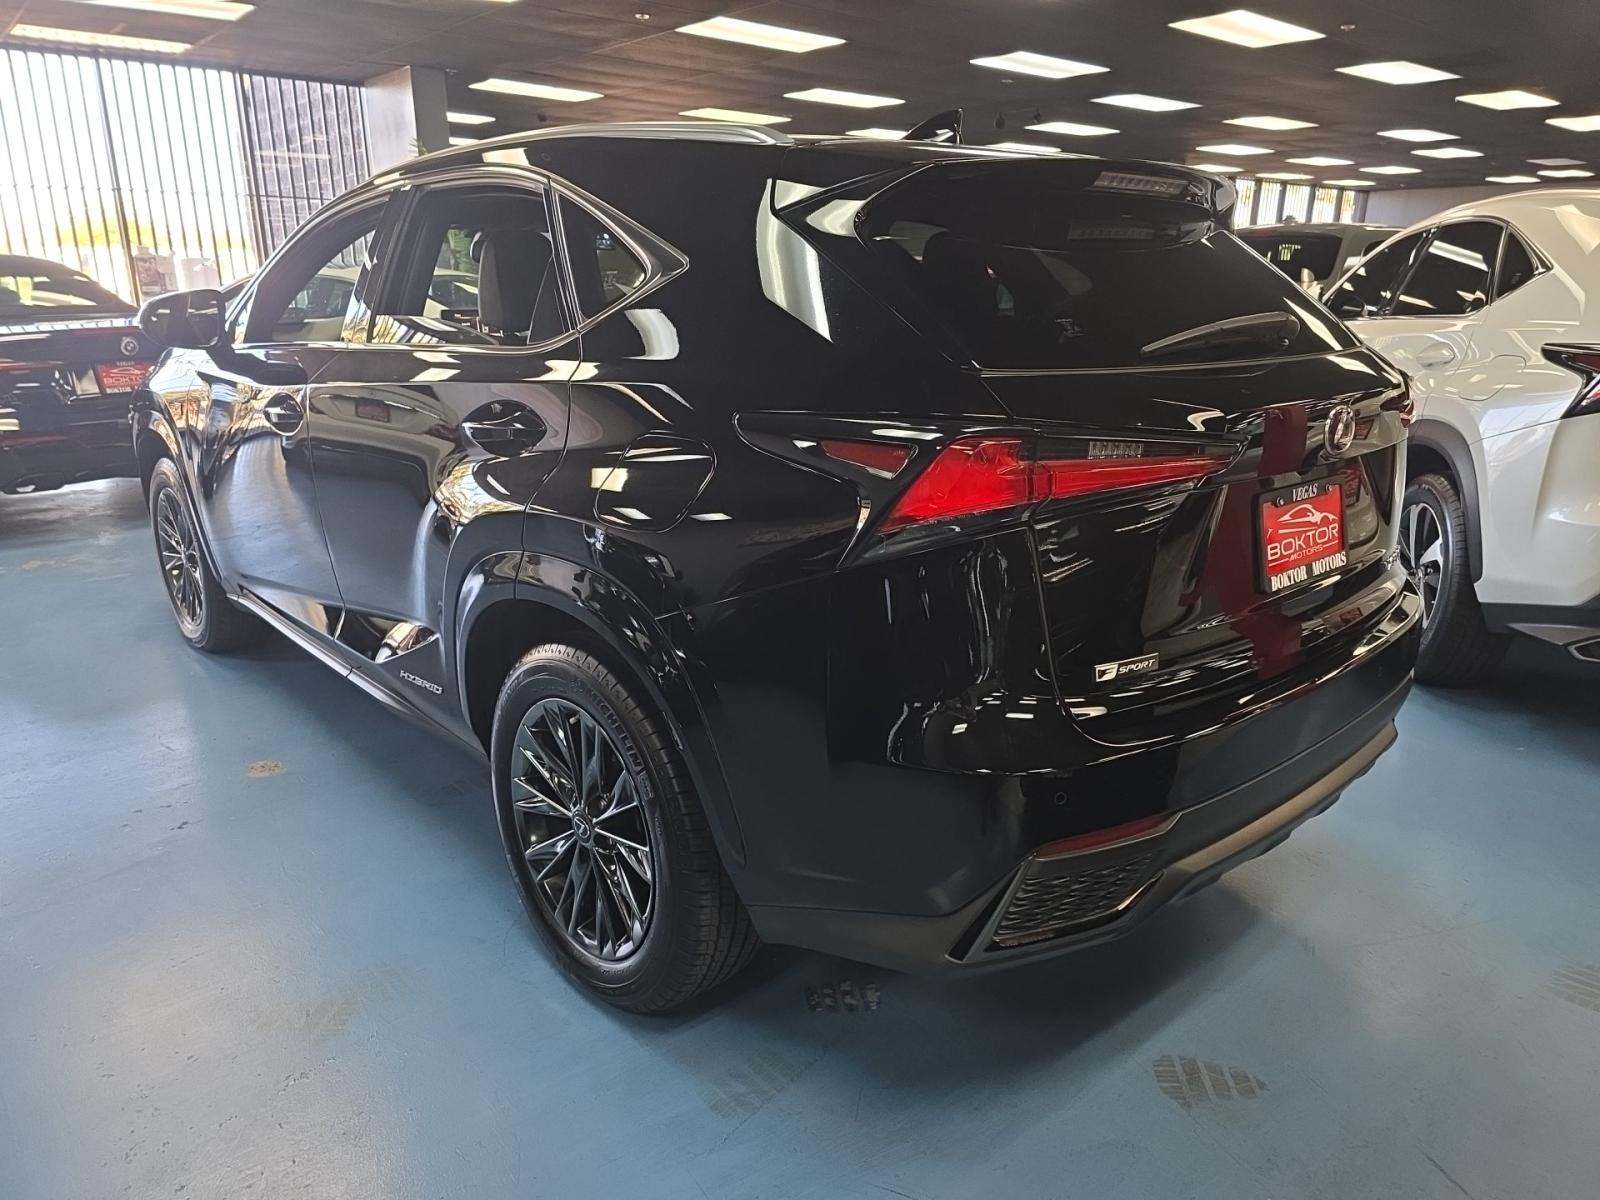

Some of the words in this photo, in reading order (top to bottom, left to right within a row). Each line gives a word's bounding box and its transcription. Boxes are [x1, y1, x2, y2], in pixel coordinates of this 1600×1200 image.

[1292, 483, 1318, 502] VEGAS
[1267, 523, 1339, 561] BOKTOR
[1289, 544, 1324, 561] MOTORS
[1271, 566, 1308, 592] BOKTOR
[1312, 551, 1347, 576] MOTORS
[1119, 659, 1156, 674] SPORT
[400, 670, 442, 694] HYBRID
